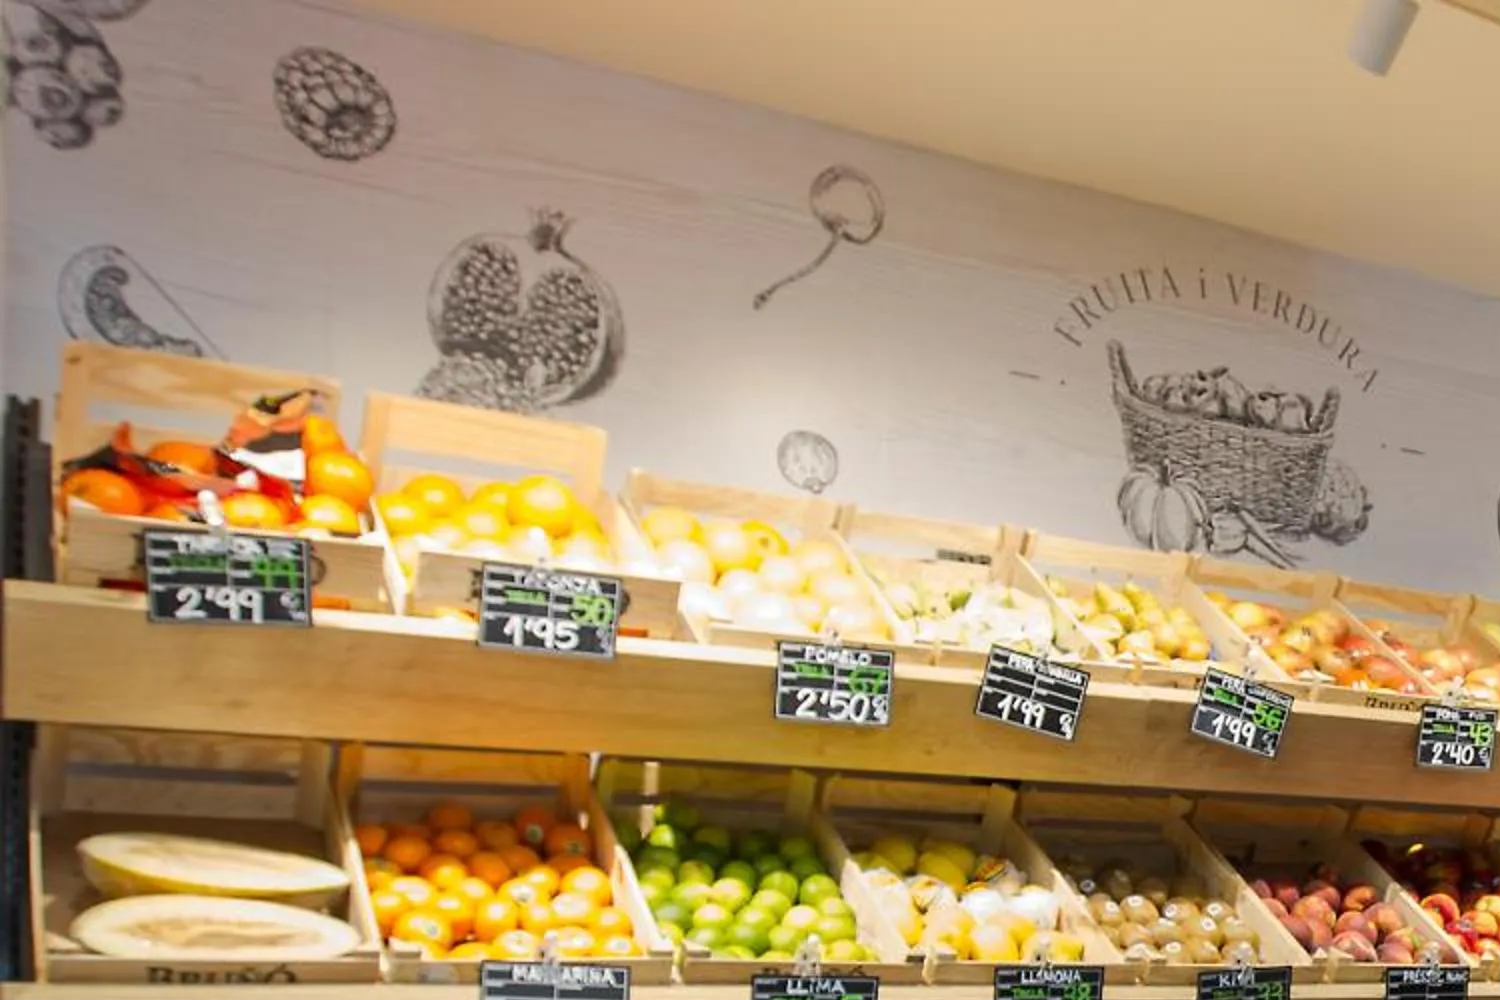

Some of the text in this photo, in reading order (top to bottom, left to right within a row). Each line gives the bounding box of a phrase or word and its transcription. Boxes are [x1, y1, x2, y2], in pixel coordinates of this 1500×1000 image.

[1054, 267, 1181, 347] FRUITA
[1226, 271, 1380, 392] VERDURA
[174, 587, 265, 623] 2'99
[571, 593, 614, 626] 50
[503, 615, 580, 651] 1'95
[795, 687, 870, 724] 2'50
[997, 694, 1046, 729] 1'99
[1252, 702, 1281, 734] 56
[1211, 712, 1256, 748] 1'99
[1431, 741, 1475, 766] 2'40
[512, 964, 617, 986] MAARINA
